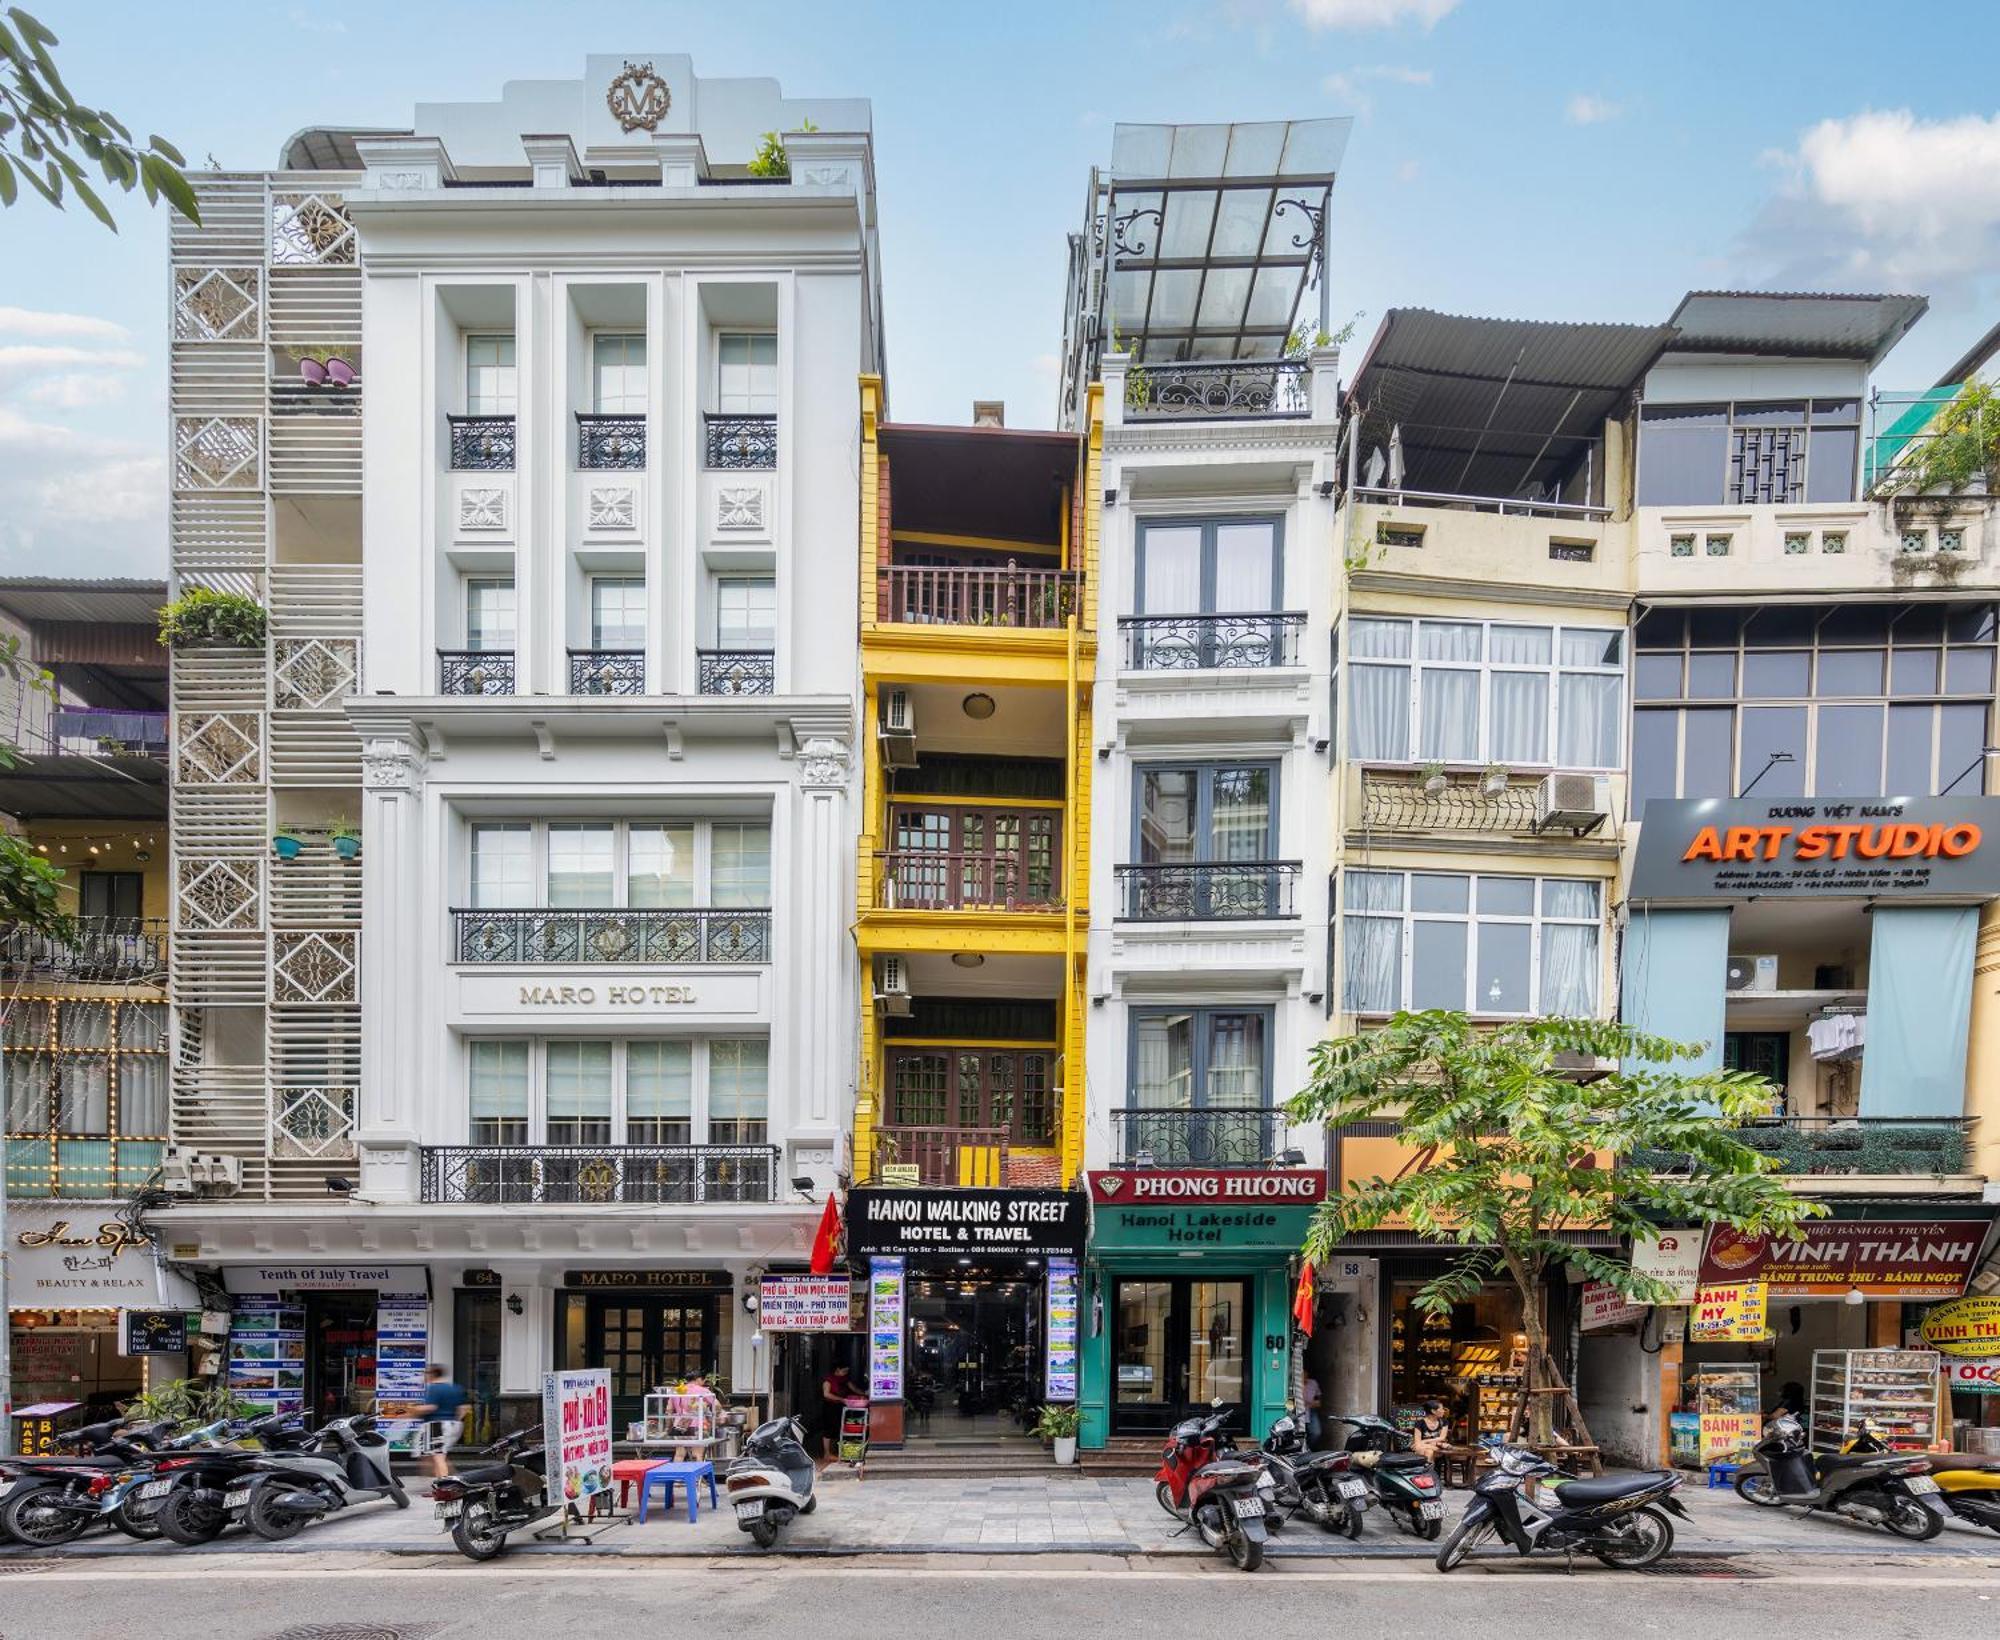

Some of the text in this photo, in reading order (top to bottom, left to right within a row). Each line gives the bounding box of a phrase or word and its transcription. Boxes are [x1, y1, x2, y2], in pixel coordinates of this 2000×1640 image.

[1681, 823, 1983, 863] ART STUDIO
[520, 986, 697, 1004] MARO HOTEL
[1133, 1176, 1316, 1197] PHONG HƯƠNG
[867, 1199, 1069, 1223] HANOI WALKING STREET
[1121, 1212, 1277, 1227] Hanoi Lakeside
[900, 1227, 1032, 1241] HOTEL & TRAVEL
[1168, 1228, 1221, 1242] Hotel
[1873, 1226, 1894, 1235] GIA
[62, 1255, 114, 1272] 한스파
[1344, 1263, 1359, 1275] 58
[259, 1269, 390, 1283] Tenth Of July Travel
[476, 1273, 493, 1284] 64
[582, 1273, 712, 1285] MARO HOTEL
[1759, 1270, 1795, 1282] BÁNH
[1799, 1272, 1844, 1282] TRUNG
[1847, 1272, 1873, 1282] THU
[1884, 1271, 1922, 1282] BÁNH
[36, 1279, 144, 1288] BEAUTY & RELAX
[1266, 1335, 1285, 1350] 60
